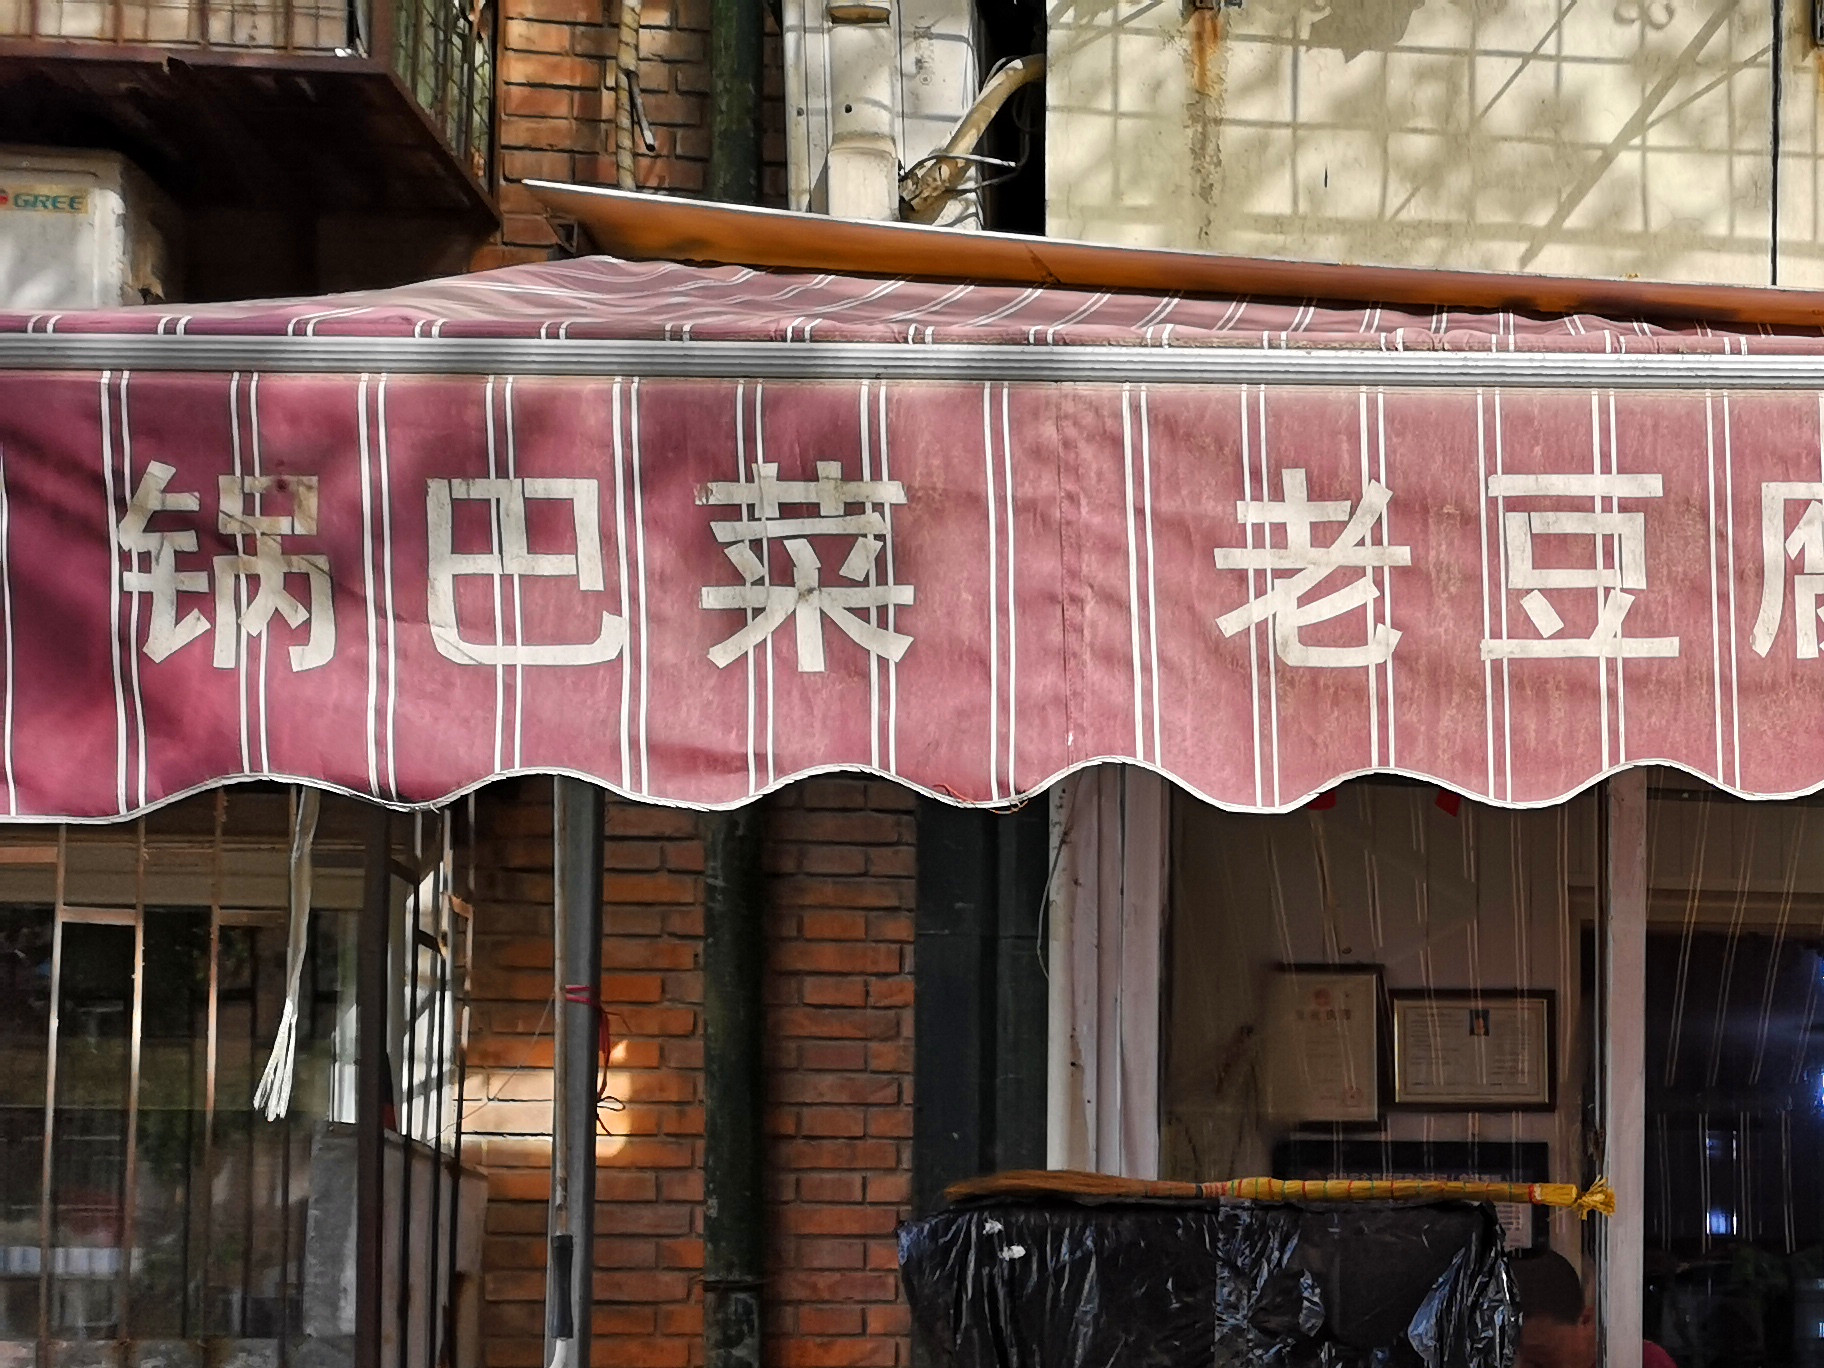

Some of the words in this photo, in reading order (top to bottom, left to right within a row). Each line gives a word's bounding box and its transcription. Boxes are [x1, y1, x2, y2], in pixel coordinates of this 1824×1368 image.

[13, 193, 84, 211] GREE
[119, 460, 914, 674] 锅巴菜
